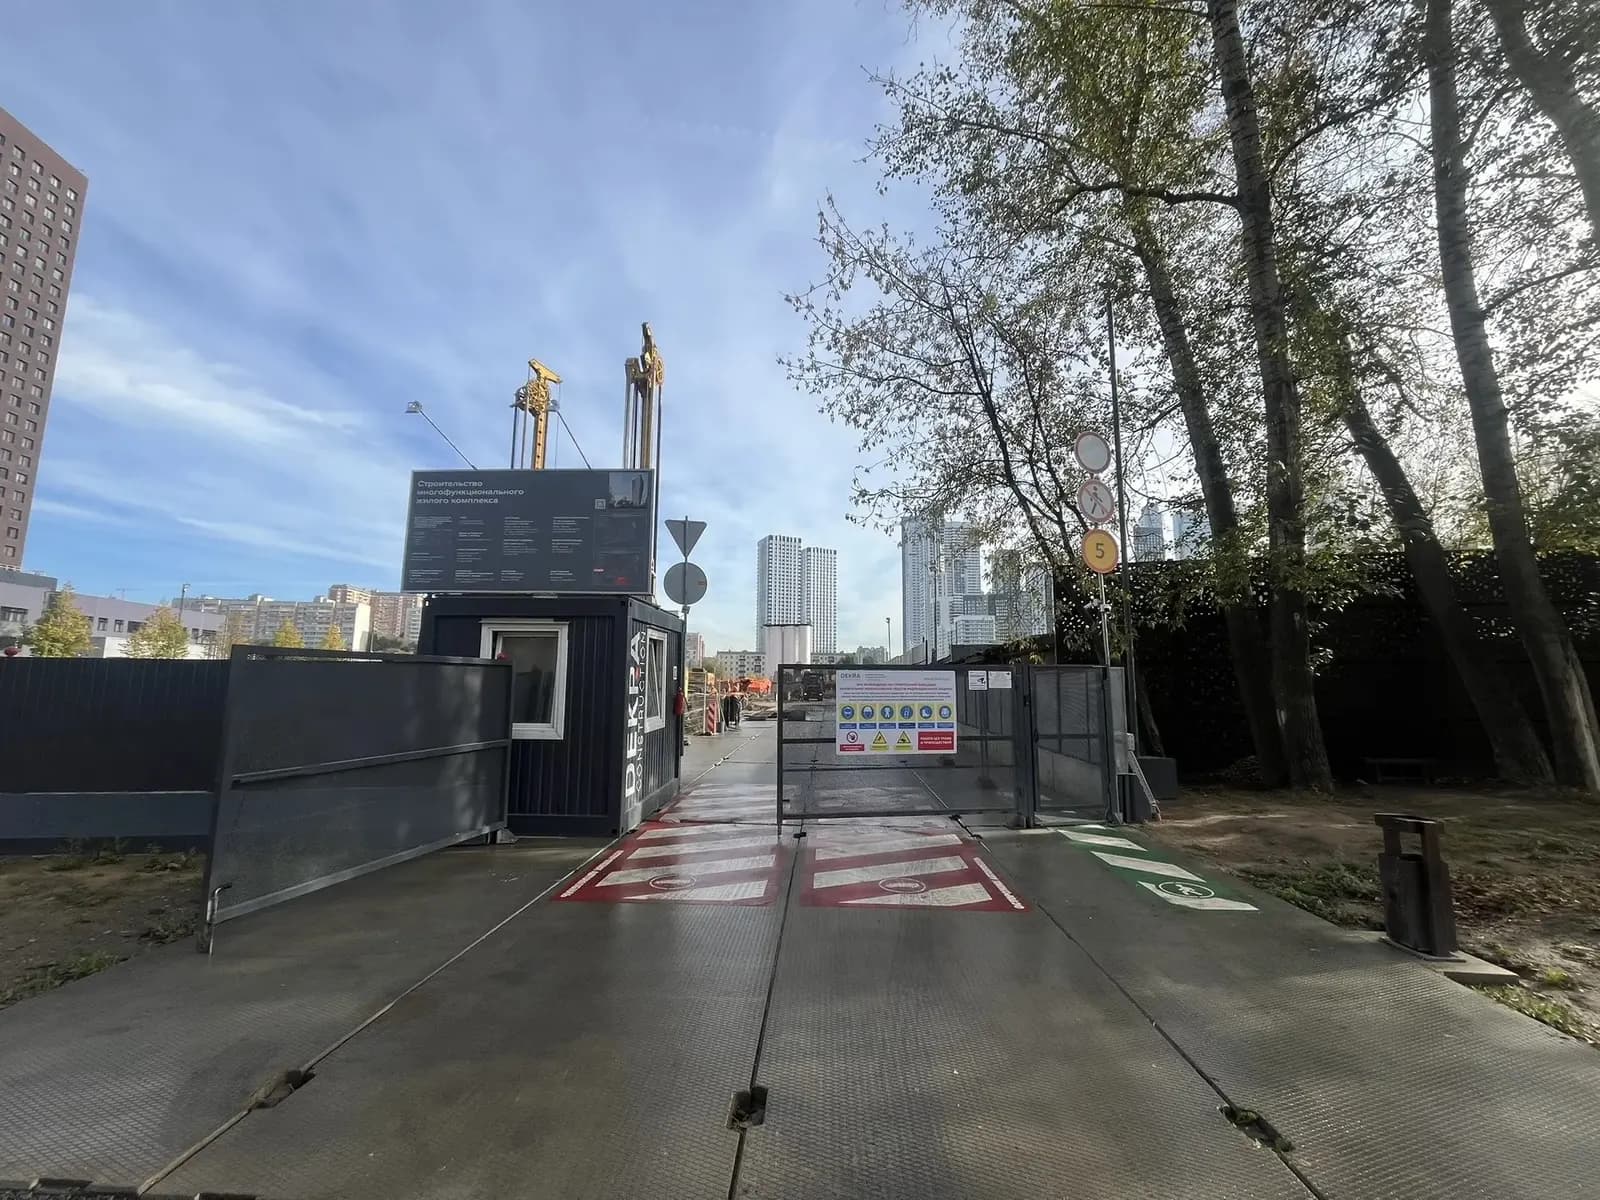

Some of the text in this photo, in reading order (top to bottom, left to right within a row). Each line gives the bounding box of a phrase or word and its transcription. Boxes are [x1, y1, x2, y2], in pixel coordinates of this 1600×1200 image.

[417, 480, 483, 488] Строительство
[416, 488, 525, 497] многофункционального
[416, 497, 499, 505] жилого комплекса
[1095, 542, 1105, 559] 5
[635, 630, 647, 793] CONSTRUCTION
